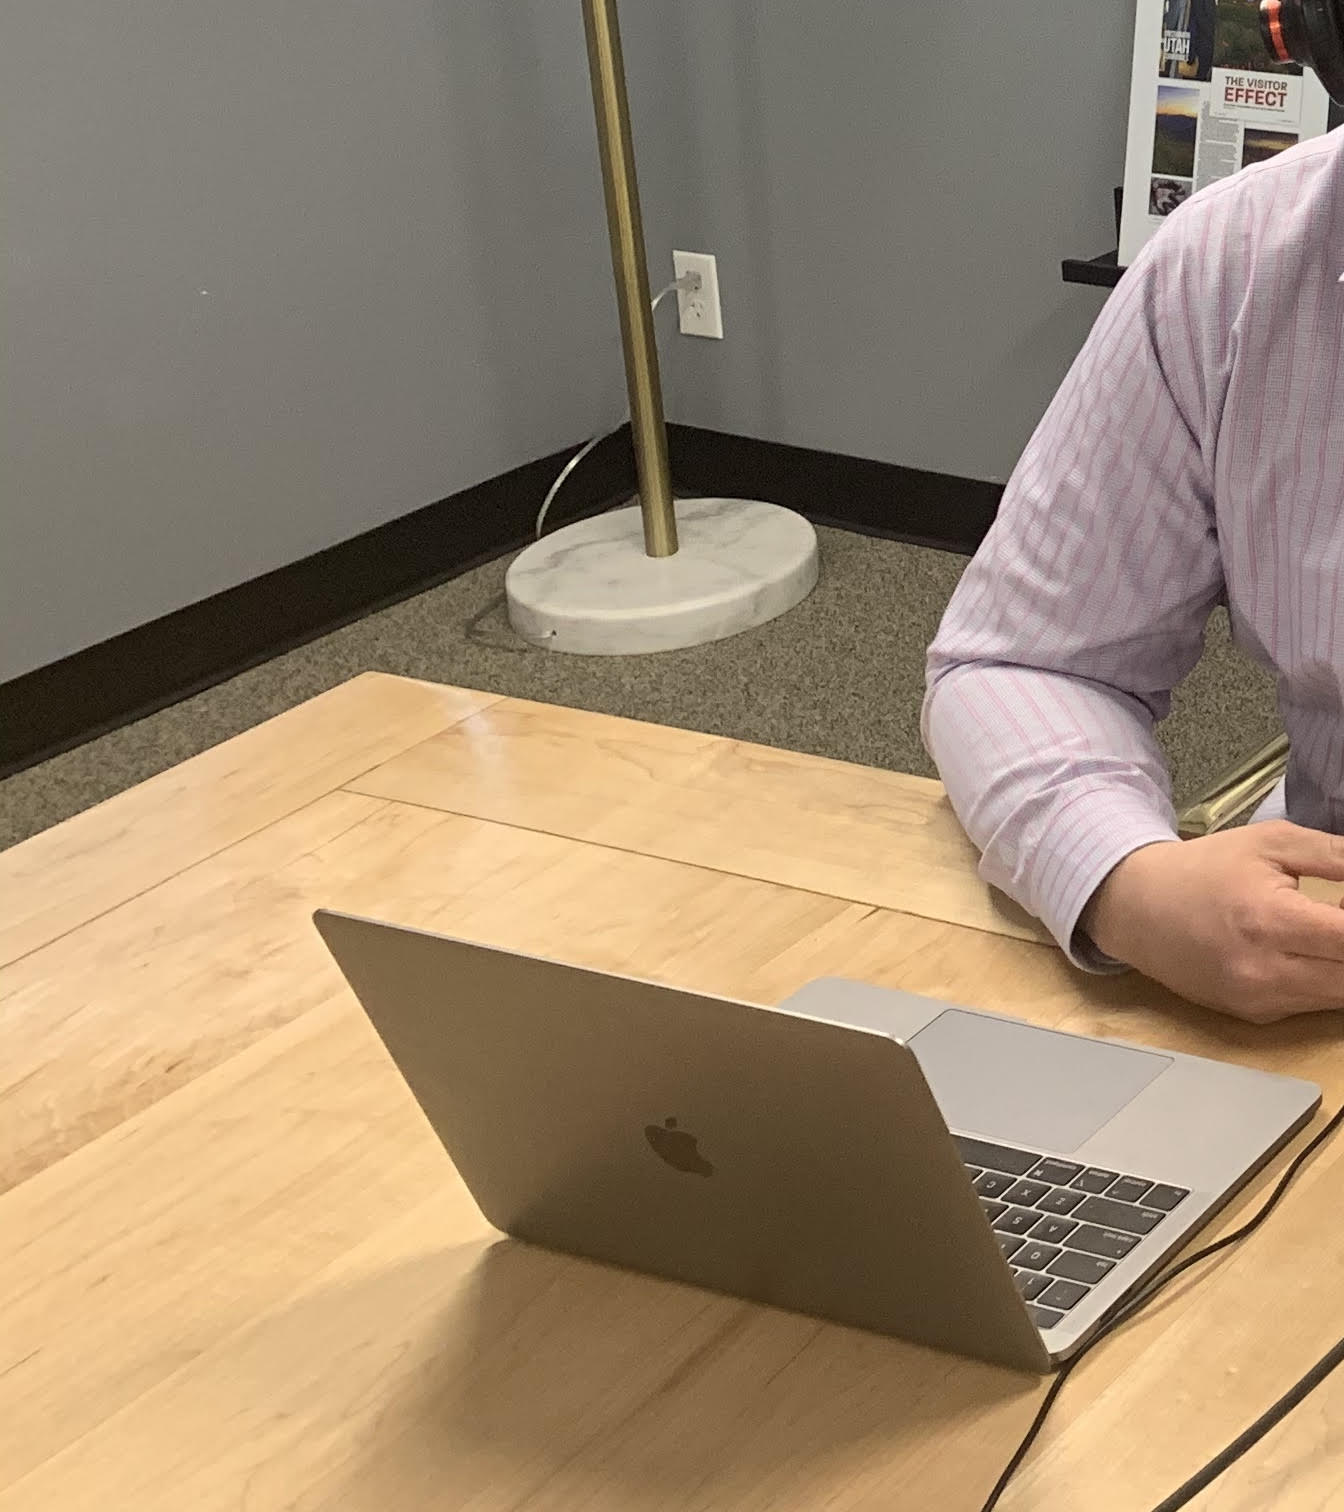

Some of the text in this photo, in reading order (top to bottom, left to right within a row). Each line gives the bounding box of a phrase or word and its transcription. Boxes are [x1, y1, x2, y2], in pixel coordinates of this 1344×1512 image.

[1163, 37, 1190, 55] UTAH
[1225, 76, 1288, 90] THE VISITOR
[1224, 87, 1287, 107] EFFECT
